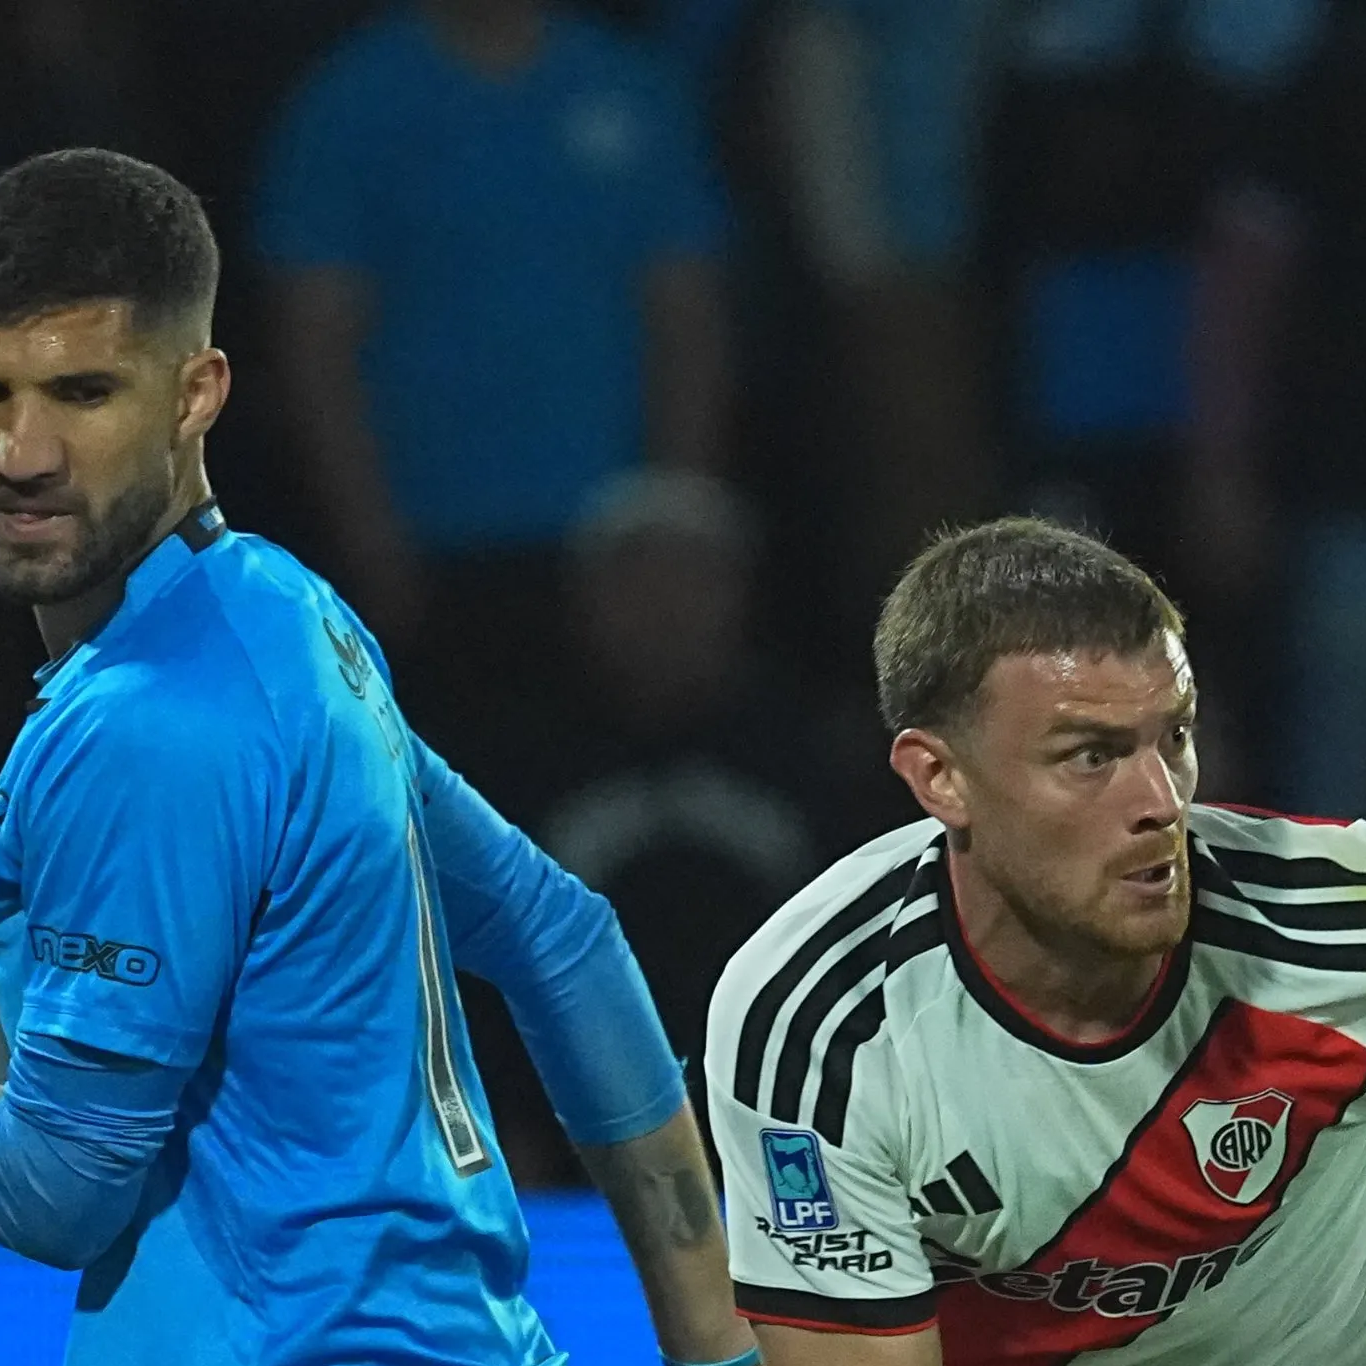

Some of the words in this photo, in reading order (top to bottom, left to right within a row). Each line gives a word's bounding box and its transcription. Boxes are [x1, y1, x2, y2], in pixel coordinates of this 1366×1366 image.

[27, 923, 162, 987] nexo
[778, 1201, 832, 1226] LPF
[919, 1222, 1285, 1318] etan
